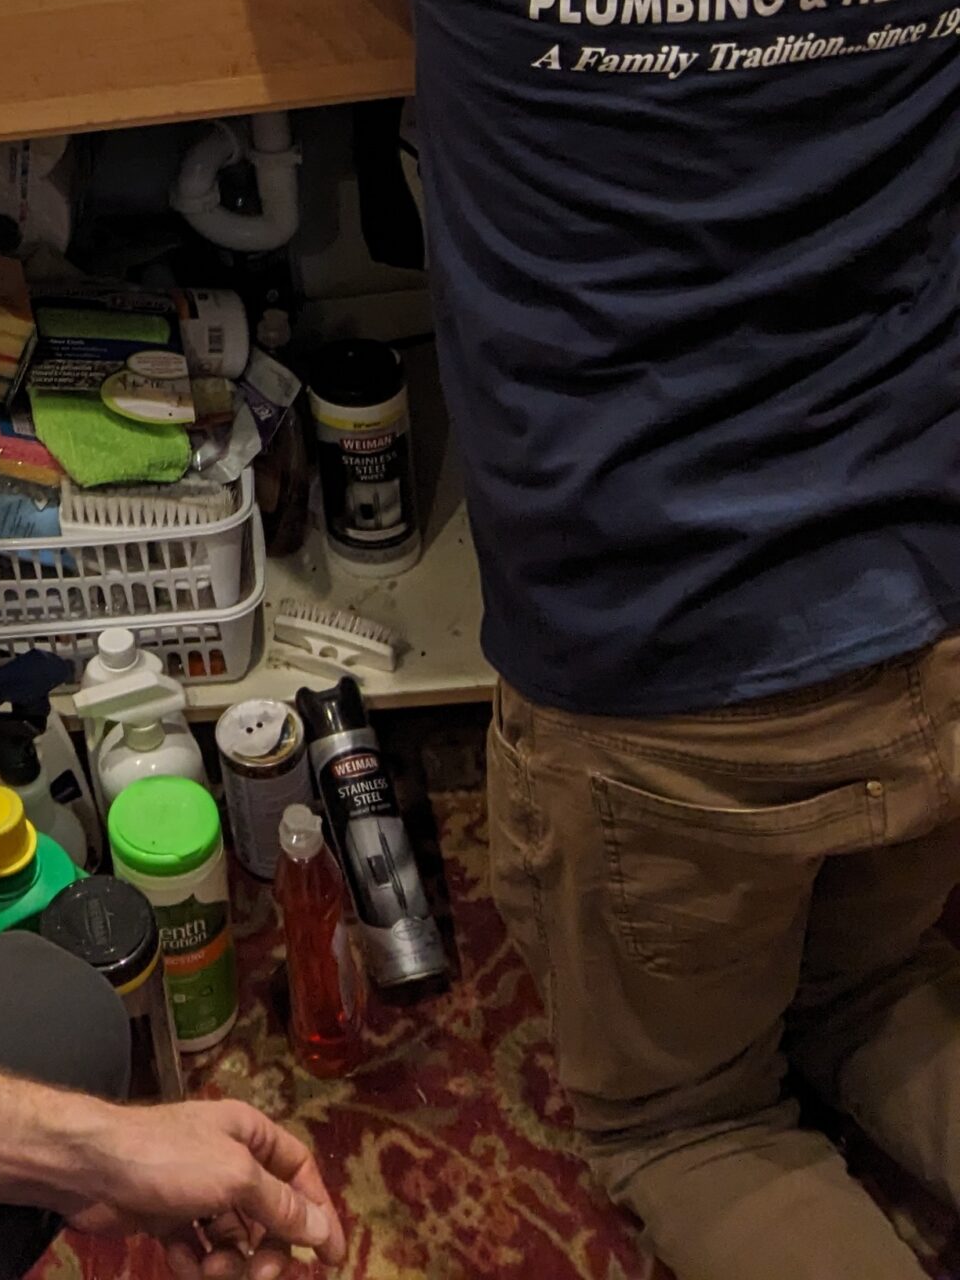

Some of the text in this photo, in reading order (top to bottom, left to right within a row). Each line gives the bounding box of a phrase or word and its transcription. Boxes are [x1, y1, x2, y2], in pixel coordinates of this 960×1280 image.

[531, 44, 562, 70] A
[571, 45, 700, 80] Family
[928, 7, 960, 39] 19
[343, 434, 392, 450] WEIMAN
[335, 758, 378, 776] WEIMAN
[338, 778, 388, 799] STAINLESS
[353, 791, 383, 807] STEEL
[159, 919, 206, 940] enth
